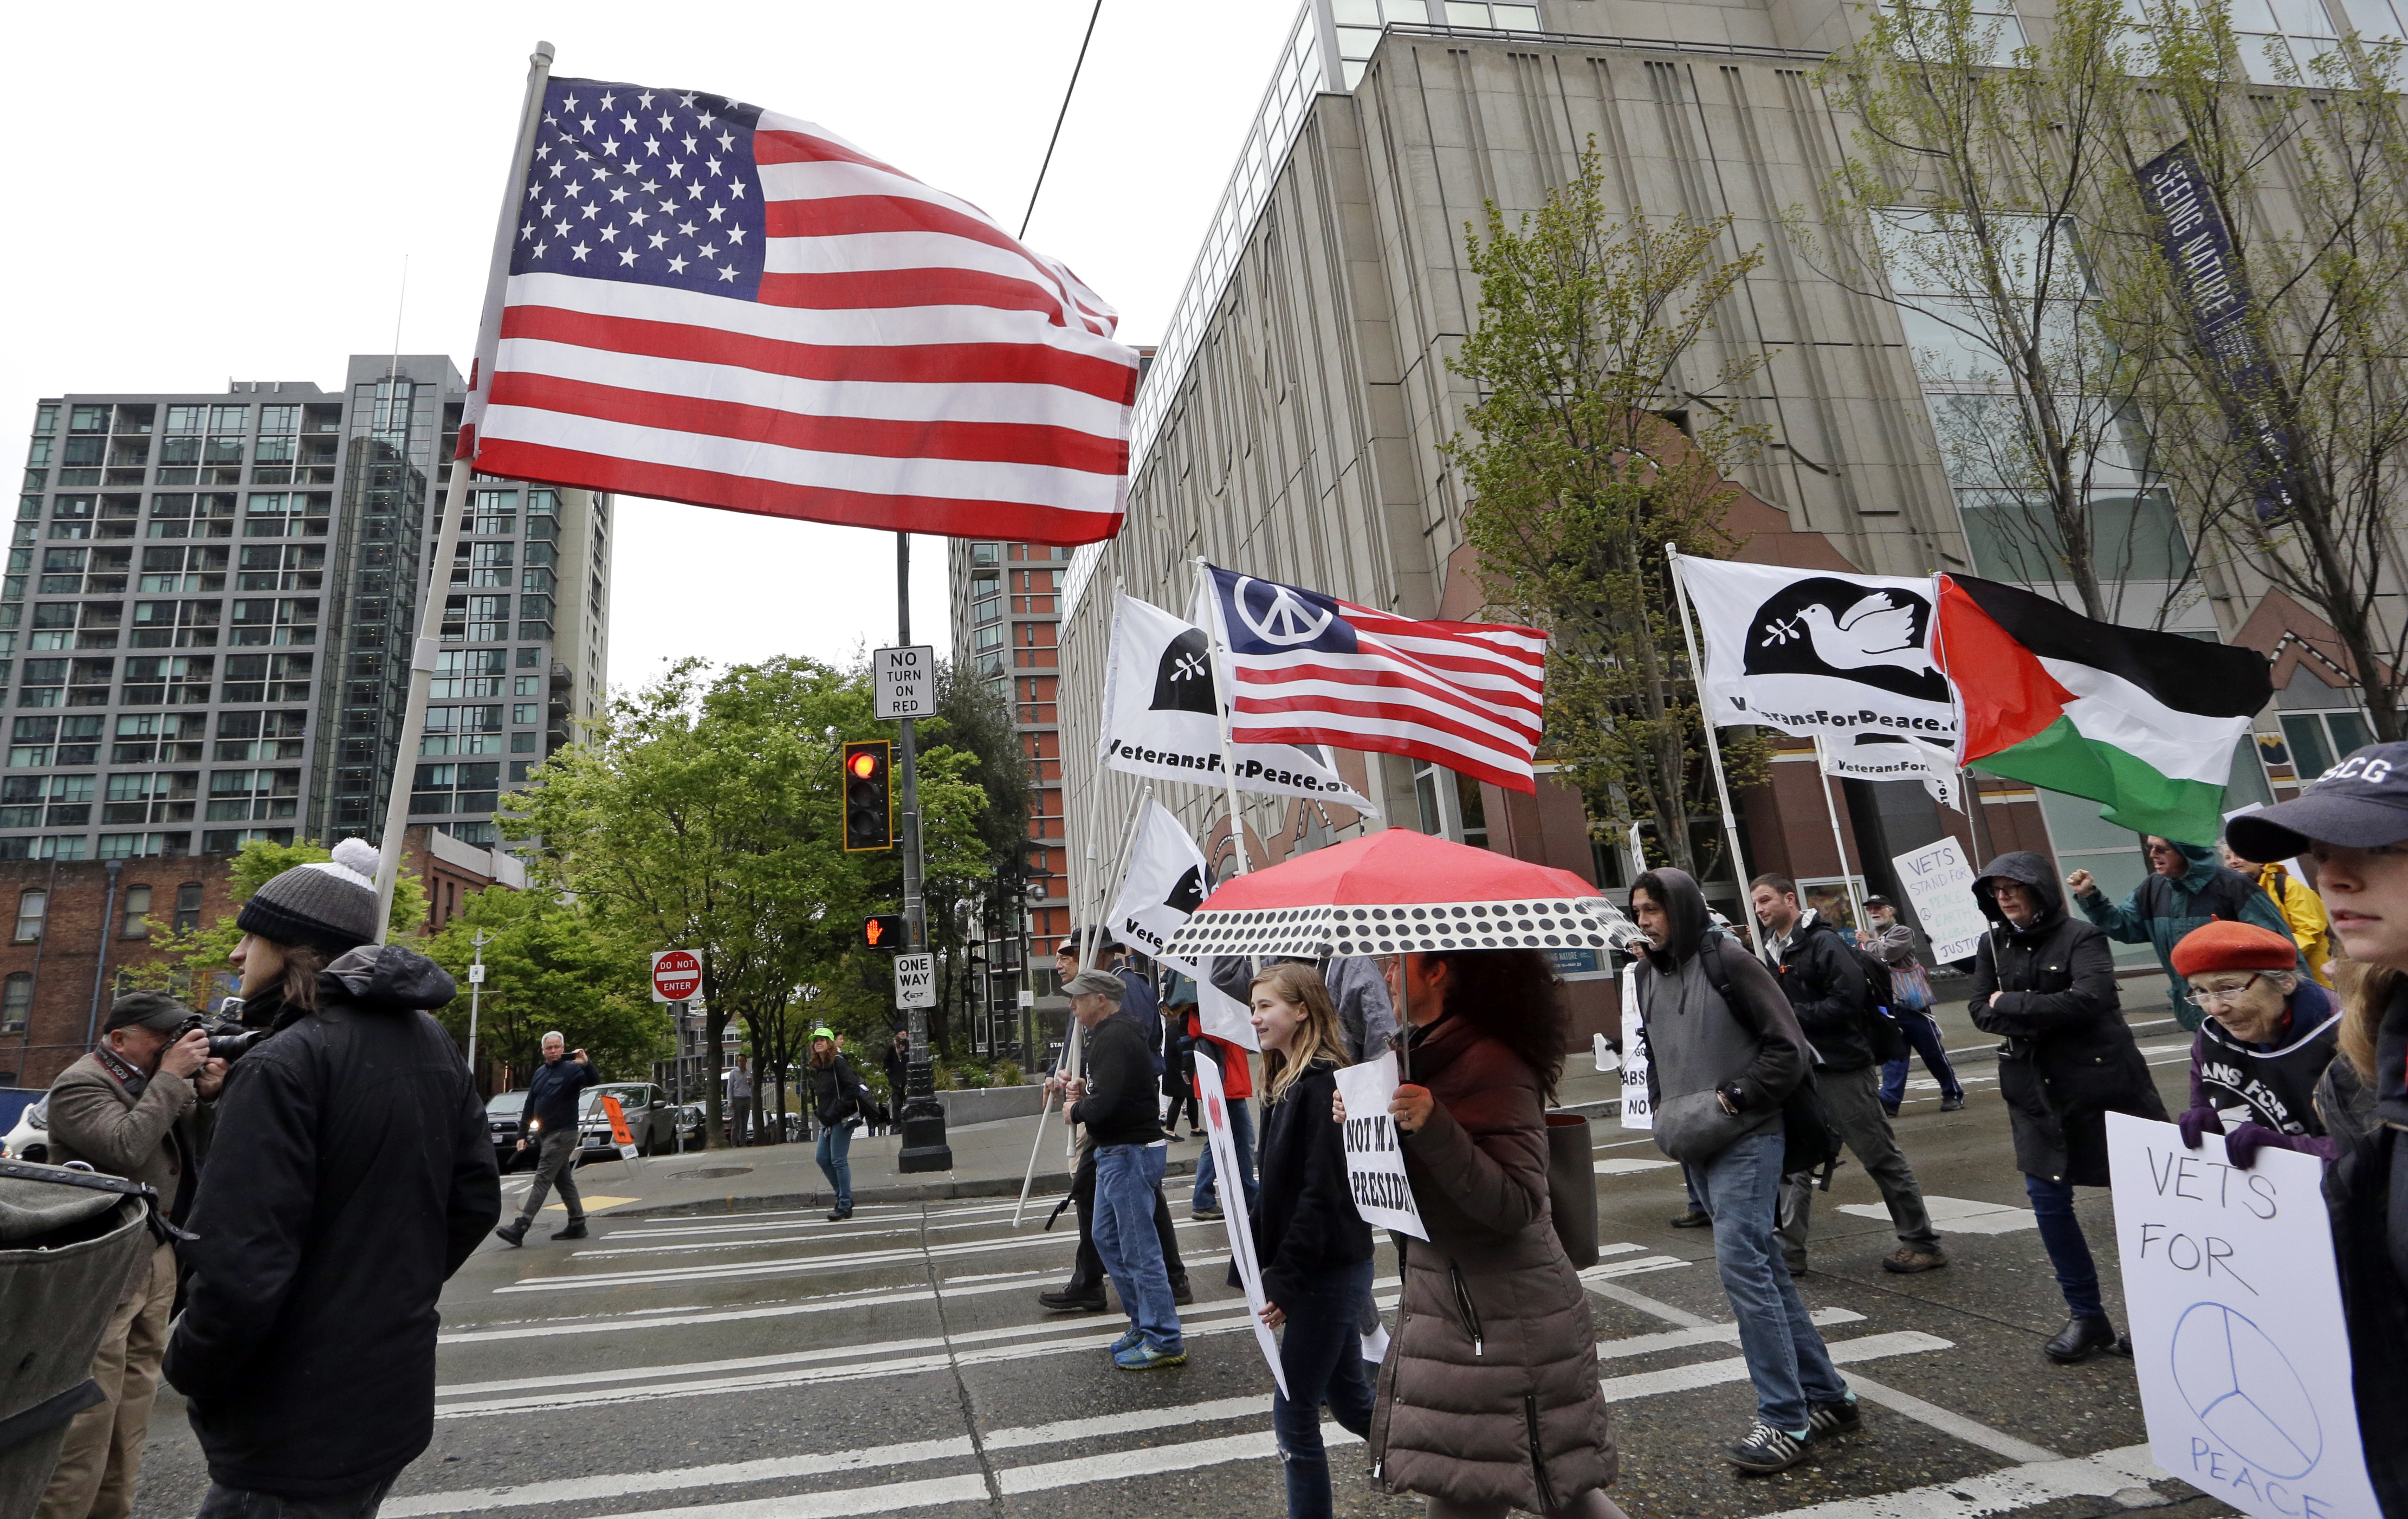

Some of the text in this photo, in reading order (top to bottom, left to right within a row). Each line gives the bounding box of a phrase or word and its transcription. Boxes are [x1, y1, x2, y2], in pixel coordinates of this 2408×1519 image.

[2152, 159, 2204, 237] SEEING
[891, 652, 916, 667] NO
[887, 670, 921, 682] TURN
[896, 686, 913, 696] ON
[893, 700, 918, 712] RED
[1907, 848, 1954, 876] VETS
[1910, 867, 1970, 896] STAND FOR
[1940, 936, 1981, 958] JUSTIC
[660, 960, 694, 969] DO NOT
[899, 958, 928, 972] ONE
[664, 981, 691, 991] ENTER
[899, 973, 930, 987] WAY
[2201, 1061, 2243, 1086] ANS
[2244, 1080, 2288, 1121] FOR
[1629, 1100, 1653, 1115] NO
[1347, 1117, 1371, 1153] NOT
[2146, 1146, 2276, 1219] VETS
[2141, 1223, 2259, 1296] FOR
